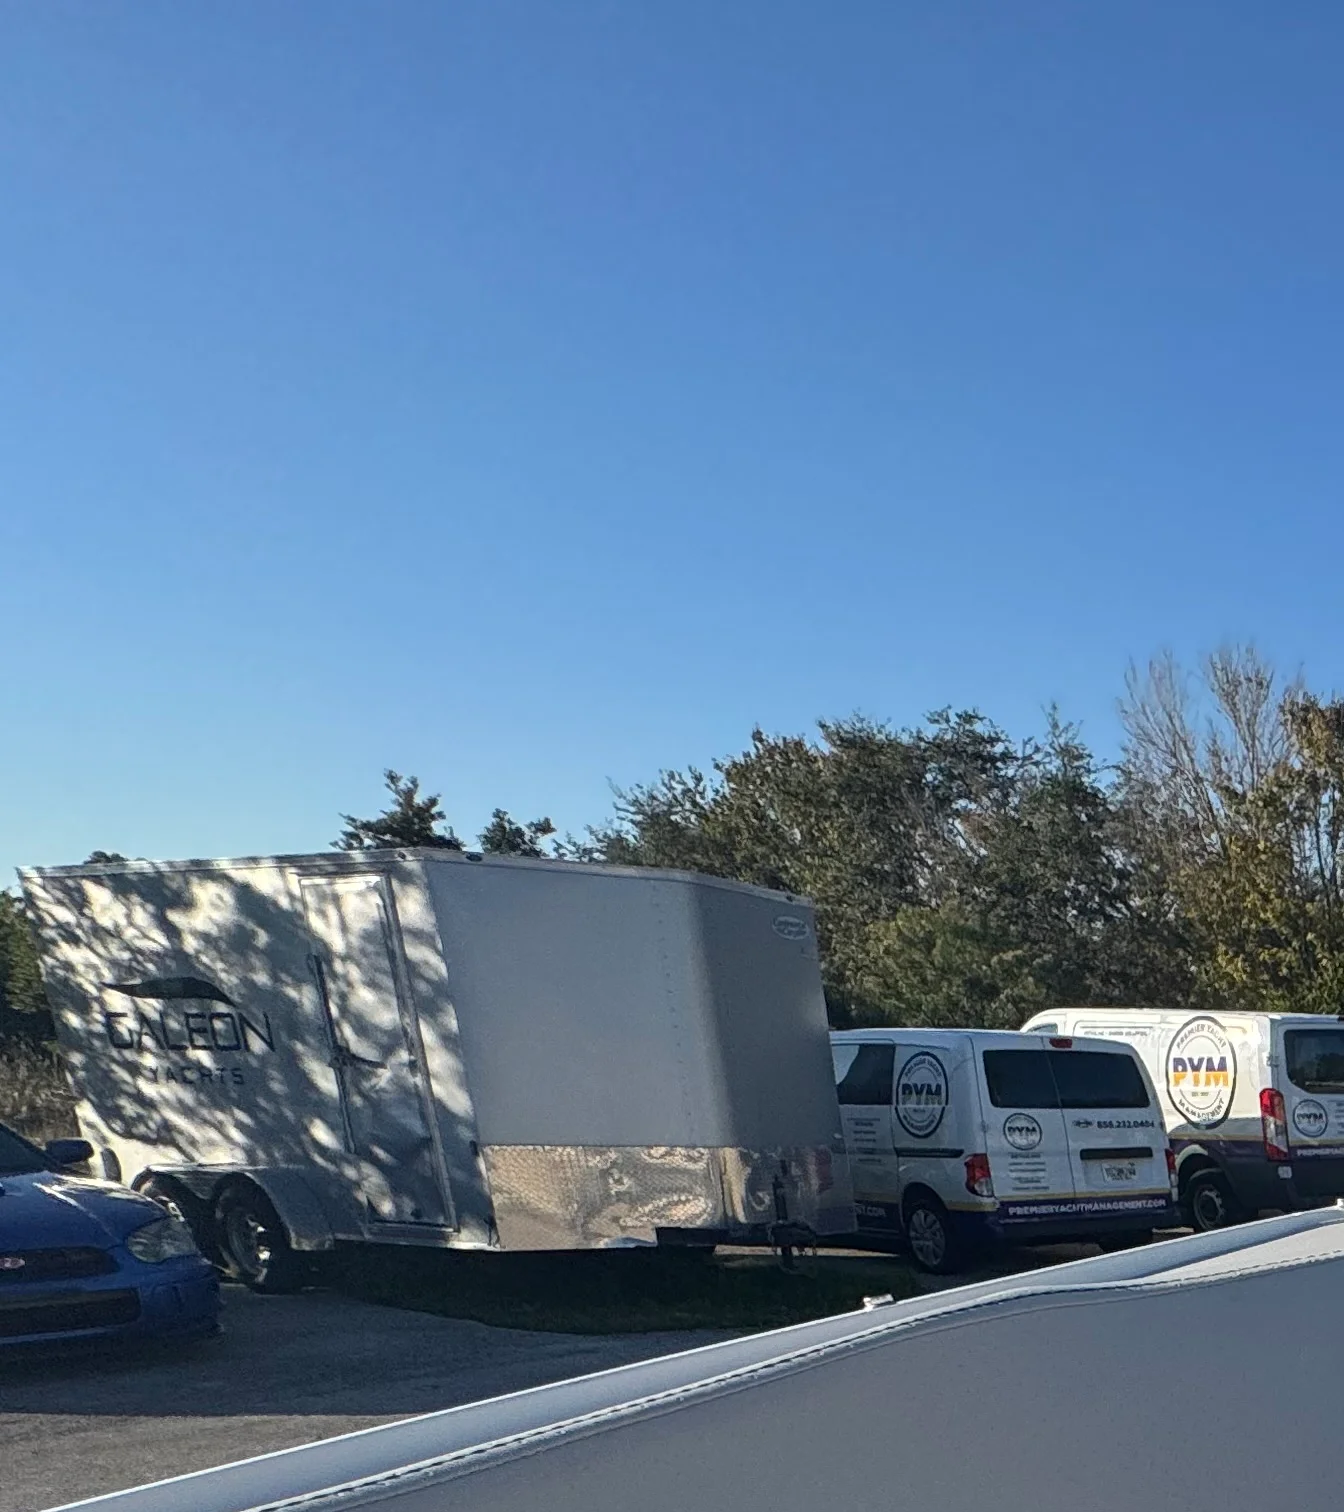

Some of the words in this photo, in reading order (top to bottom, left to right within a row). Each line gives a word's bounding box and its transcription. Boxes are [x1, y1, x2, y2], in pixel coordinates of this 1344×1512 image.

[106, 1011, 275, 1052] GALEON
[149, 1066, 244, 1085] YACHTS
[1173, 1056, 1229, 1088] PYM
[902, 1083, 942, 1105] PYM
